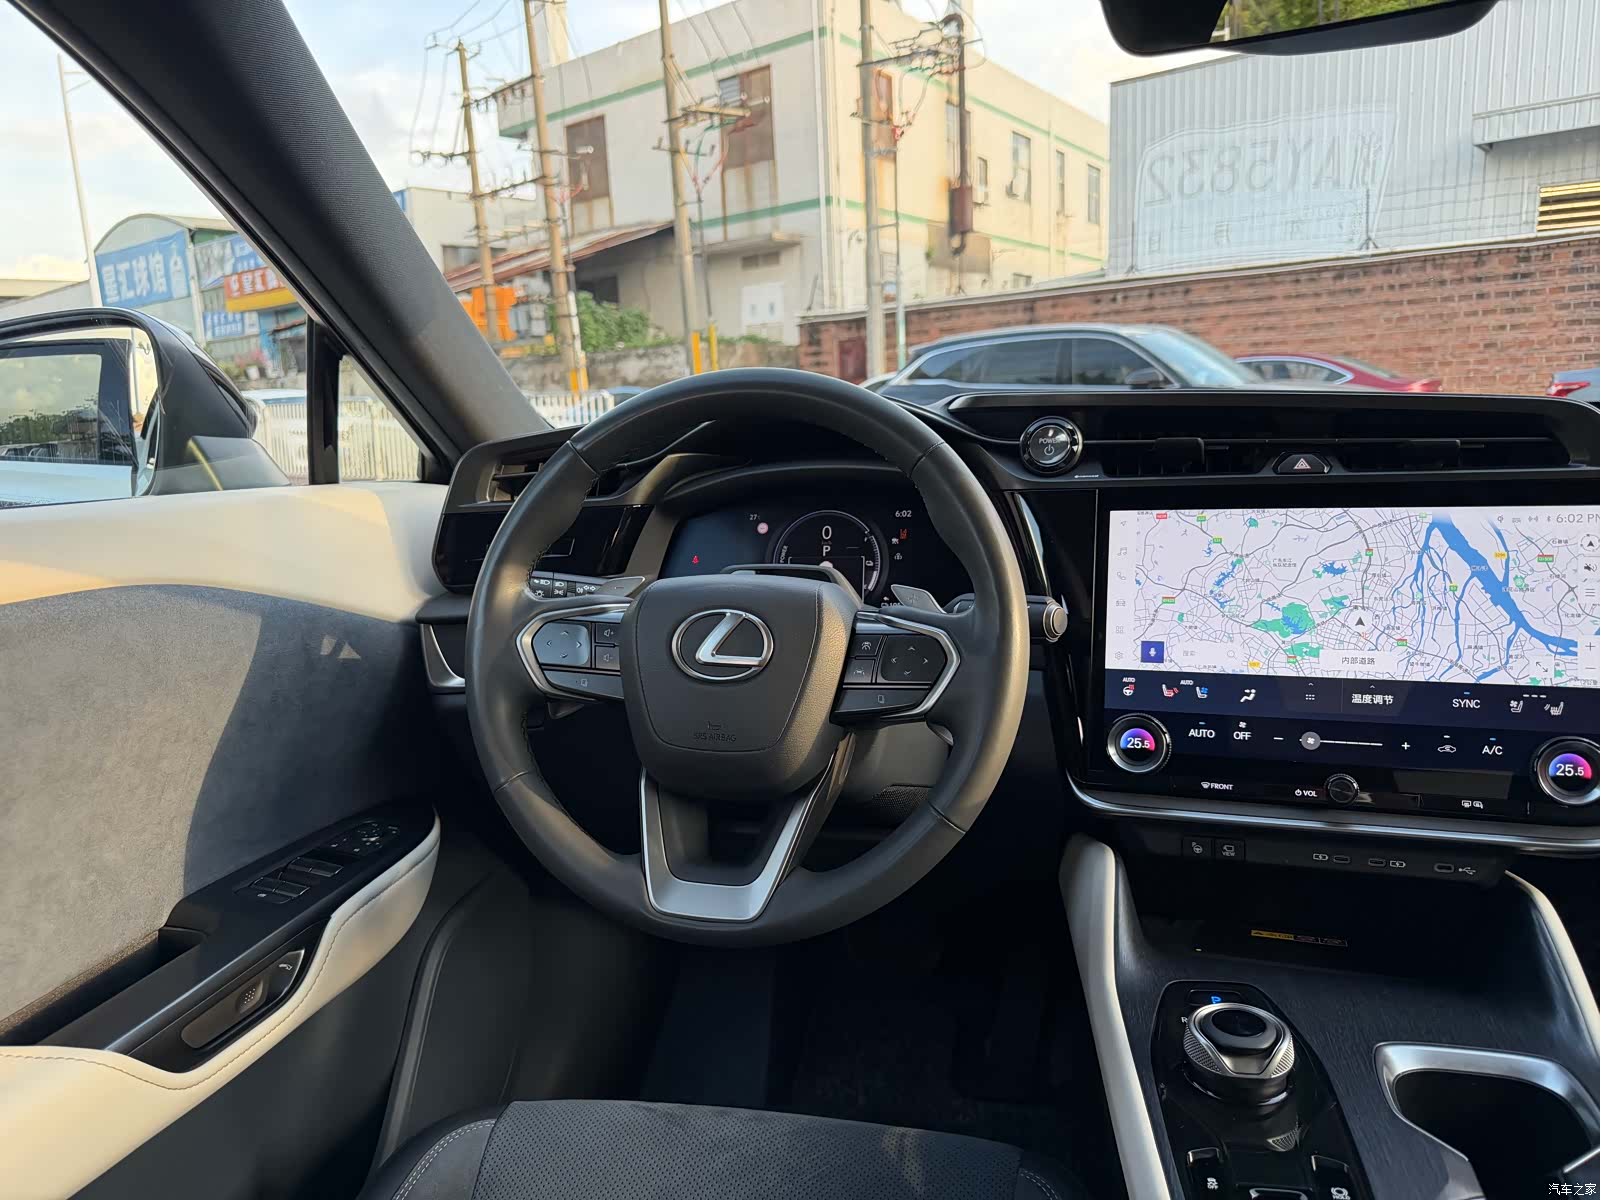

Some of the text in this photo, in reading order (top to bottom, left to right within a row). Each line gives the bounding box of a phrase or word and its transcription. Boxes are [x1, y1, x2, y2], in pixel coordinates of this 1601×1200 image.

[895, 510, 912, 518] 6:02
[1556, 513, 1584, 524] 6:02
[822, 545, 831, 557] P
[1341, 656, 1375, 665] 内部道路
[1351, 693, 1394, 705] 温度调节
[1452, 698, 1481, 709] SYNC
[709, 732, 737, 742] AIRBAG
[1188, 728, 1216, 739] AUTO
[1233, 731, 1252, 740] OFF
[1126, 737, 1151, 749] 25.5
[1481, 745, 1503, 755] A/C
[1555, 763, 1585, 777] 25.5
[1210, 782, 1234, 791] FRONT
[1302, 789, 1318, 797] VOL
[1211, 996, 1222, 1004] P
